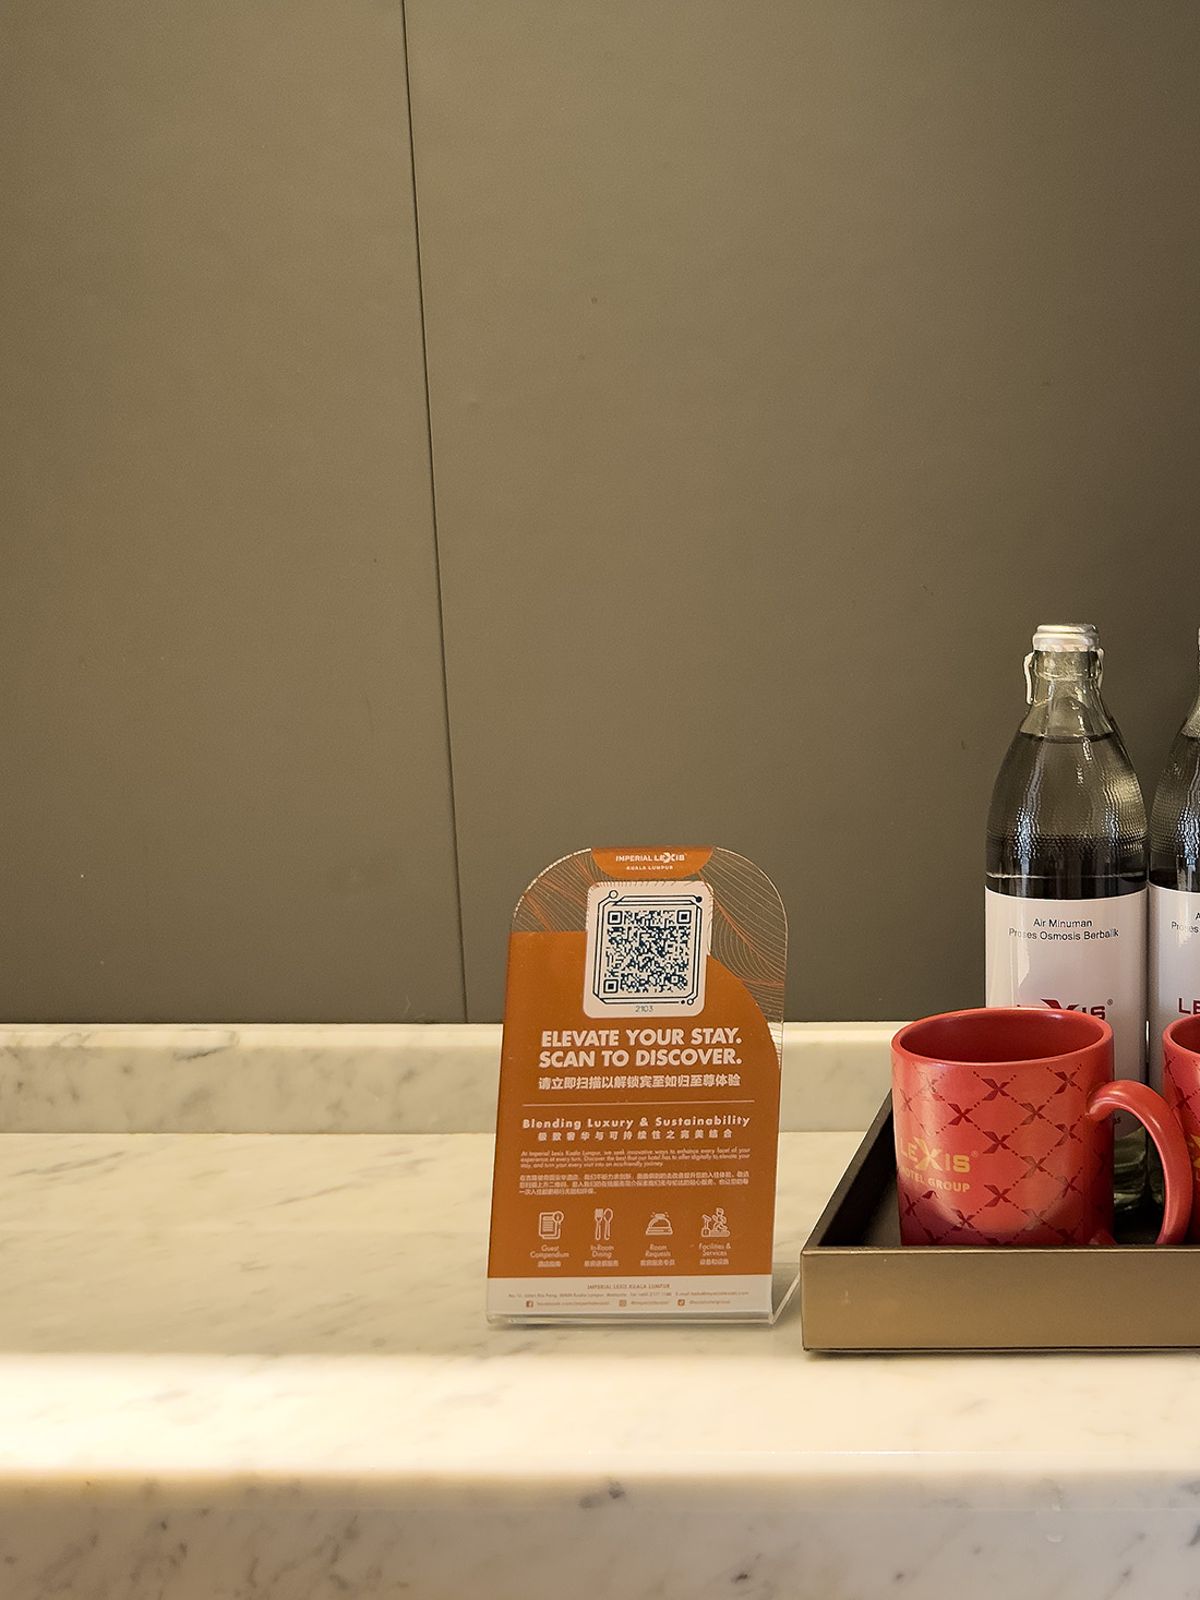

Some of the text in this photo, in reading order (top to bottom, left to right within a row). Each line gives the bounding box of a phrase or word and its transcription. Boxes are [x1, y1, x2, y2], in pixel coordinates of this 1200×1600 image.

[1033, 918, 1092, 928] Air Minuman
[1171, 921, 1199, 934] Proes
[1040, 930, 1081, 941] Osmosis
[1084, 928, 1119, 940] Berbalik
[541, 1027, 743, 1047] ELEVATE YOUR STAY.
[538, 1048, 743, 1068] SCAN TO DISCOVER.
[538, 1074, 741, 1090] 请立即扫描以解锁宾至如归至尊体验
[522, 1115, 751, 1130] Blending Luxury & Sustainability
[927, 1177, 970, 1193] GROUP
